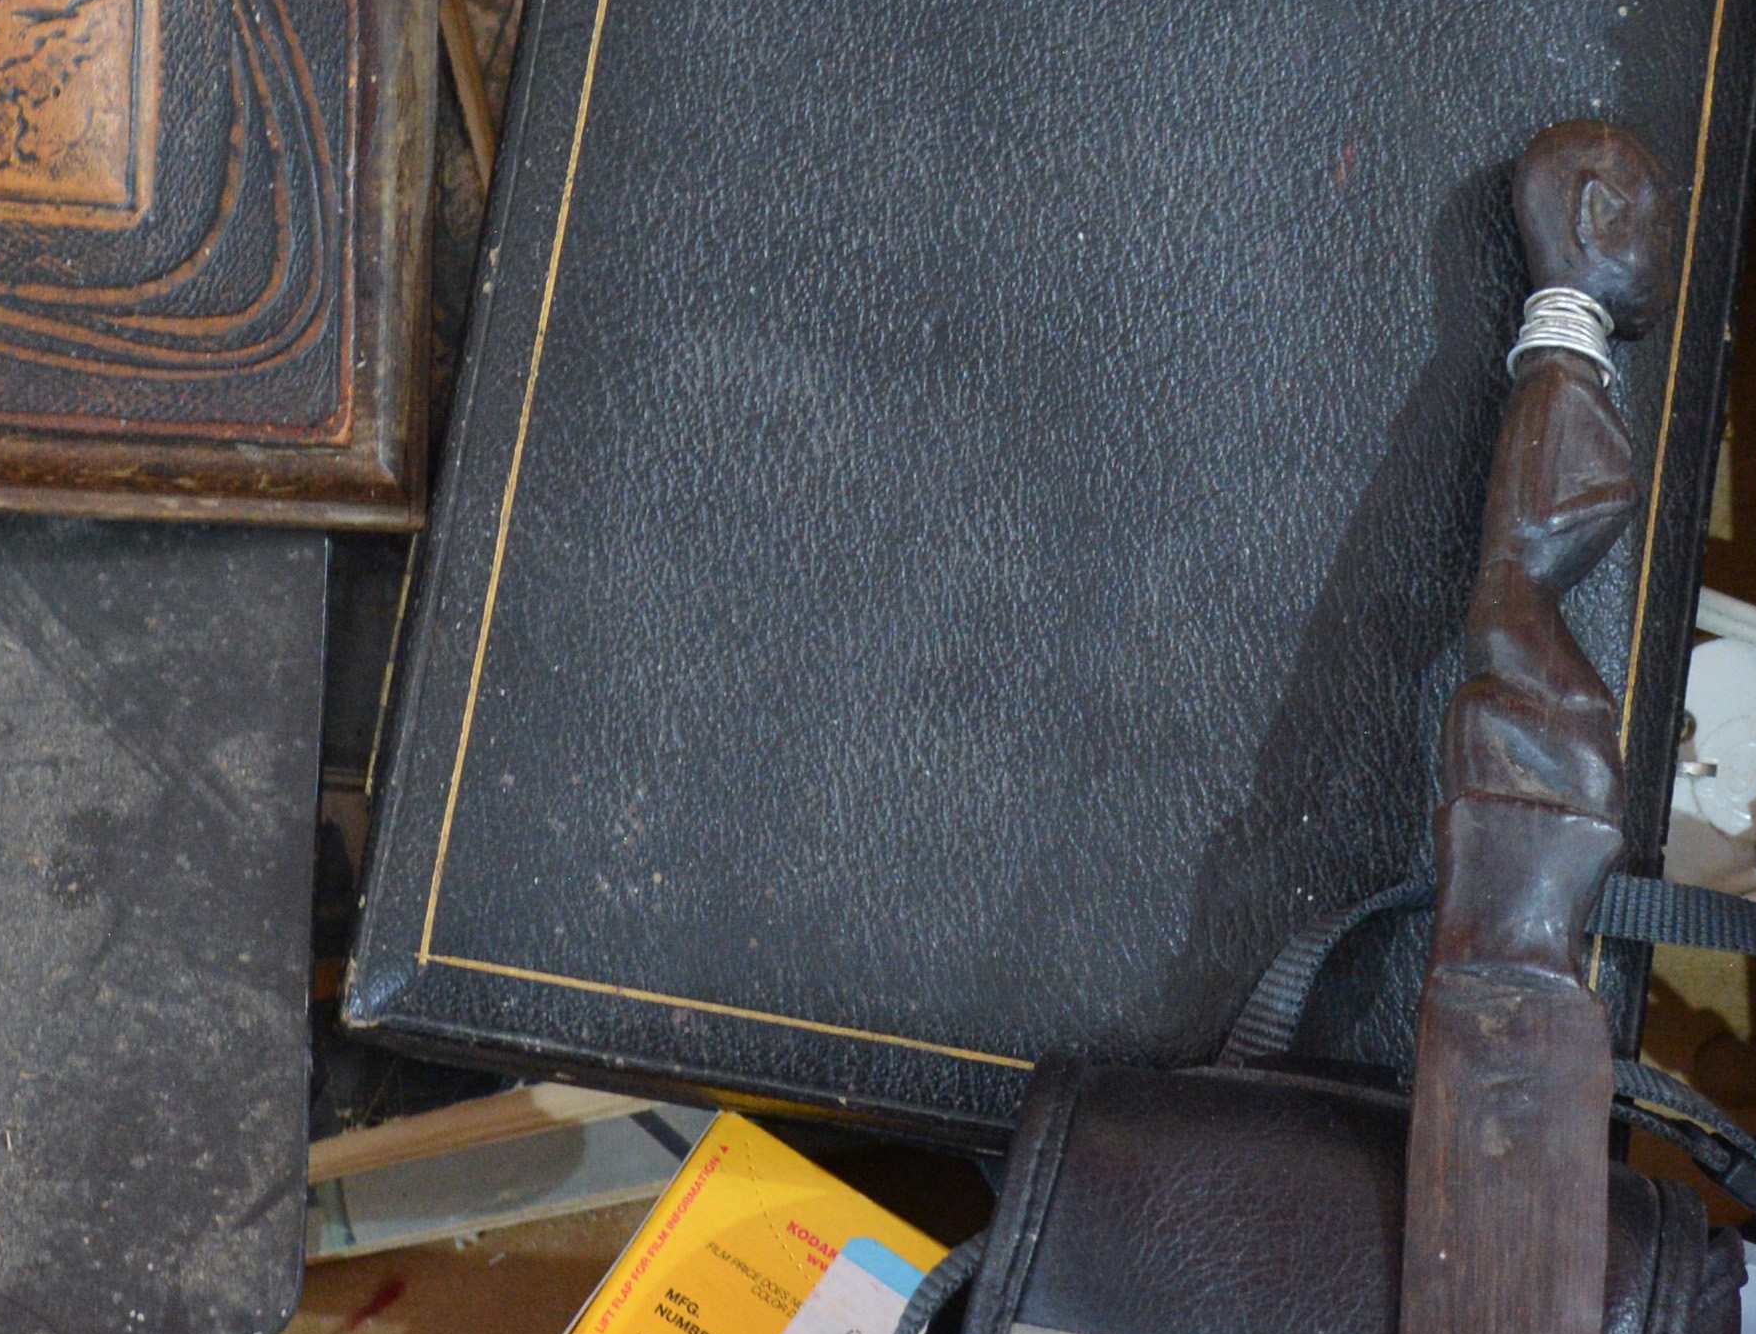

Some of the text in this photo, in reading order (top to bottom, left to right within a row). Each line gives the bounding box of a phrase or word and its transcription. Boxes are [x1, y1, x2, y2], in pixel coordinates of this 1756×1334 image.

[596, 1154, 721, 1334] LIFT FLAP FOR FILM INFORMATION
[731, 1257, 762, 1283] PRICE
[760, 1278, 792, 1302] DOES
[664, 1287, 700, 1319] MFG.
